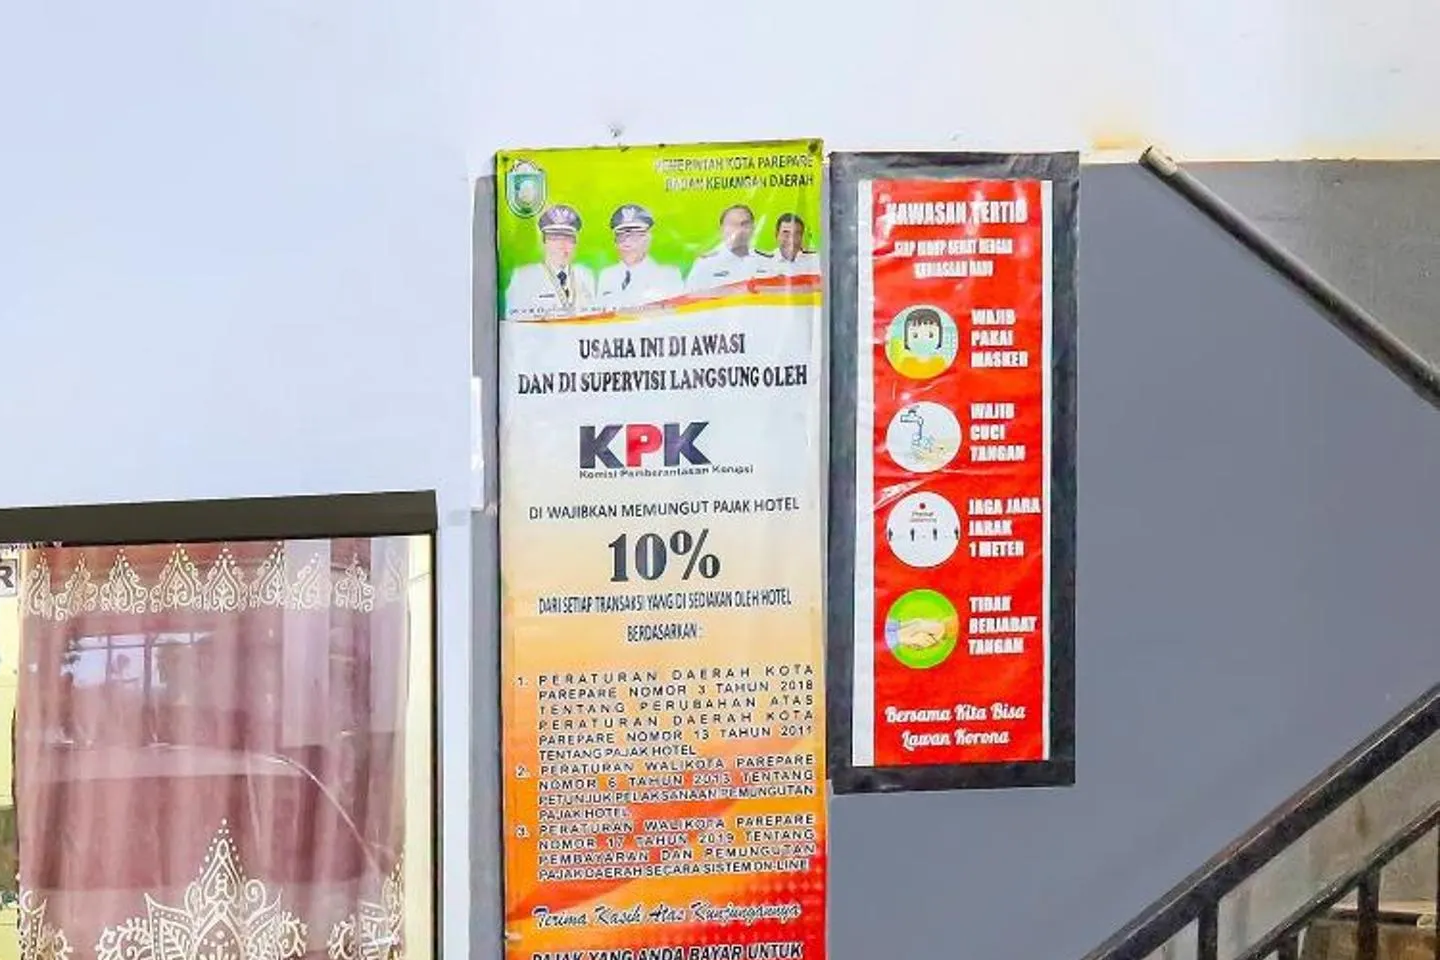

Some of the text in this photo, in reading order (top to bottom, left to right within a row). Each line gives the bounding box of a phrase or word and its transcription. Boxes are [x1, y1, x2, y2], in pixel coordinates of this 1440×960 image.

[728, 156, 755, 170] KOTA
[706, 175, 766, 190] KEUANGAN
[769, 173, 813, 187] DAERAH
[971, 309, 1017, 325] WAJIB
[579, 333, 745, 359] USAHA INI DI AWASI
[971, 330, 1013, 347] PAKAI
[971, 351, 1028, 368] MASKER
[517, 364, 808, 394] DAN DI SUPERVISI LANGSUNG OLEH
[971, 403, 1015, 419] WAJIB
[970, 424, 1006, 441] CUCI
[579, 421, 711, 470] KPK
[970, 445, 1026, 462] TANGAN
[579, 470, 618, 480] Komisi
[528, 496, 800, 521] DI WAJIBKAN MEMUNGUT PAJAK HOTEL
[607, 528, 721, 582] 10%
[969, 541, 1025, 558] 1 METER
[538, 587, 792, 615] DARI SETIAP TRANSAKSI YANG DI SEDIAKAN OLEH HOTEL
[969, 595, 1012, 613] TIDAK
[969, 616, 1038, 634] BERJABAT
[969, 637, 1025, 655] TANGAN
[538, 671, 658, 687] PERATURAN
[671, 667, 750, 681] DAERAH
[764, 664, 813, 677] KOTA
[538, 687, 618, 701] PAREPARE
[629, 684, 687, 698] NOMOR
[716, 681, 769, 694] TAHUN
[780, 679, 813, 691] 2018
[540, 694, 813, 715] TENTANG PERUBAHAN ATAS
[885, 705, 952, 724] Bersama
[991, 702, 1027, 720] Bisa
[538, 709, 813, 731] PERATURAN DAERAH KOTA
[538, 725, 812, 747] PAREPARE NOMOR 13 TAHUN 2011
[901, 728, 1010, 751] Lawan Korona
[539, 743, 697, 762] TENTANG PAJAK HOTEL
[540, 762, 634, 776] PERATURAN
[645, 758, 725, 772] WALIKOTA
[736, 753, 813, 768] PAREPARE
[538, 778, 597, 791] NOMOR
[629, 775, 683, 787] TAHUN
[742, 769, 814, 783] TENTANG
[538, 793, 612, 806] PETUNJUK
[539, 806, 631, 820] PAJAK HOTEL
[539, 822, 633, 836] PERATURAN
[736, 813, 813, 829] PAREPARE
[538, 838, 596, 850] NOMOR
[636, 834, 688, 848] TAHUN
[745, 828, 814, 843] TENTANG
[661, 848, 693, 862] DAN
[538, 868, 582, 881] PAJAK
[584, 866, 643, 880] DAERAH
[645, 863, 700, 878] SECARA
[703, 861, 752, 874] SISTEM
[532, 905, 587, 928] Terima
[594, 904, 642, 925] Kasih
[647, 902, 686, 923] Atas
[746, 942, 803, 960] UNTUK
